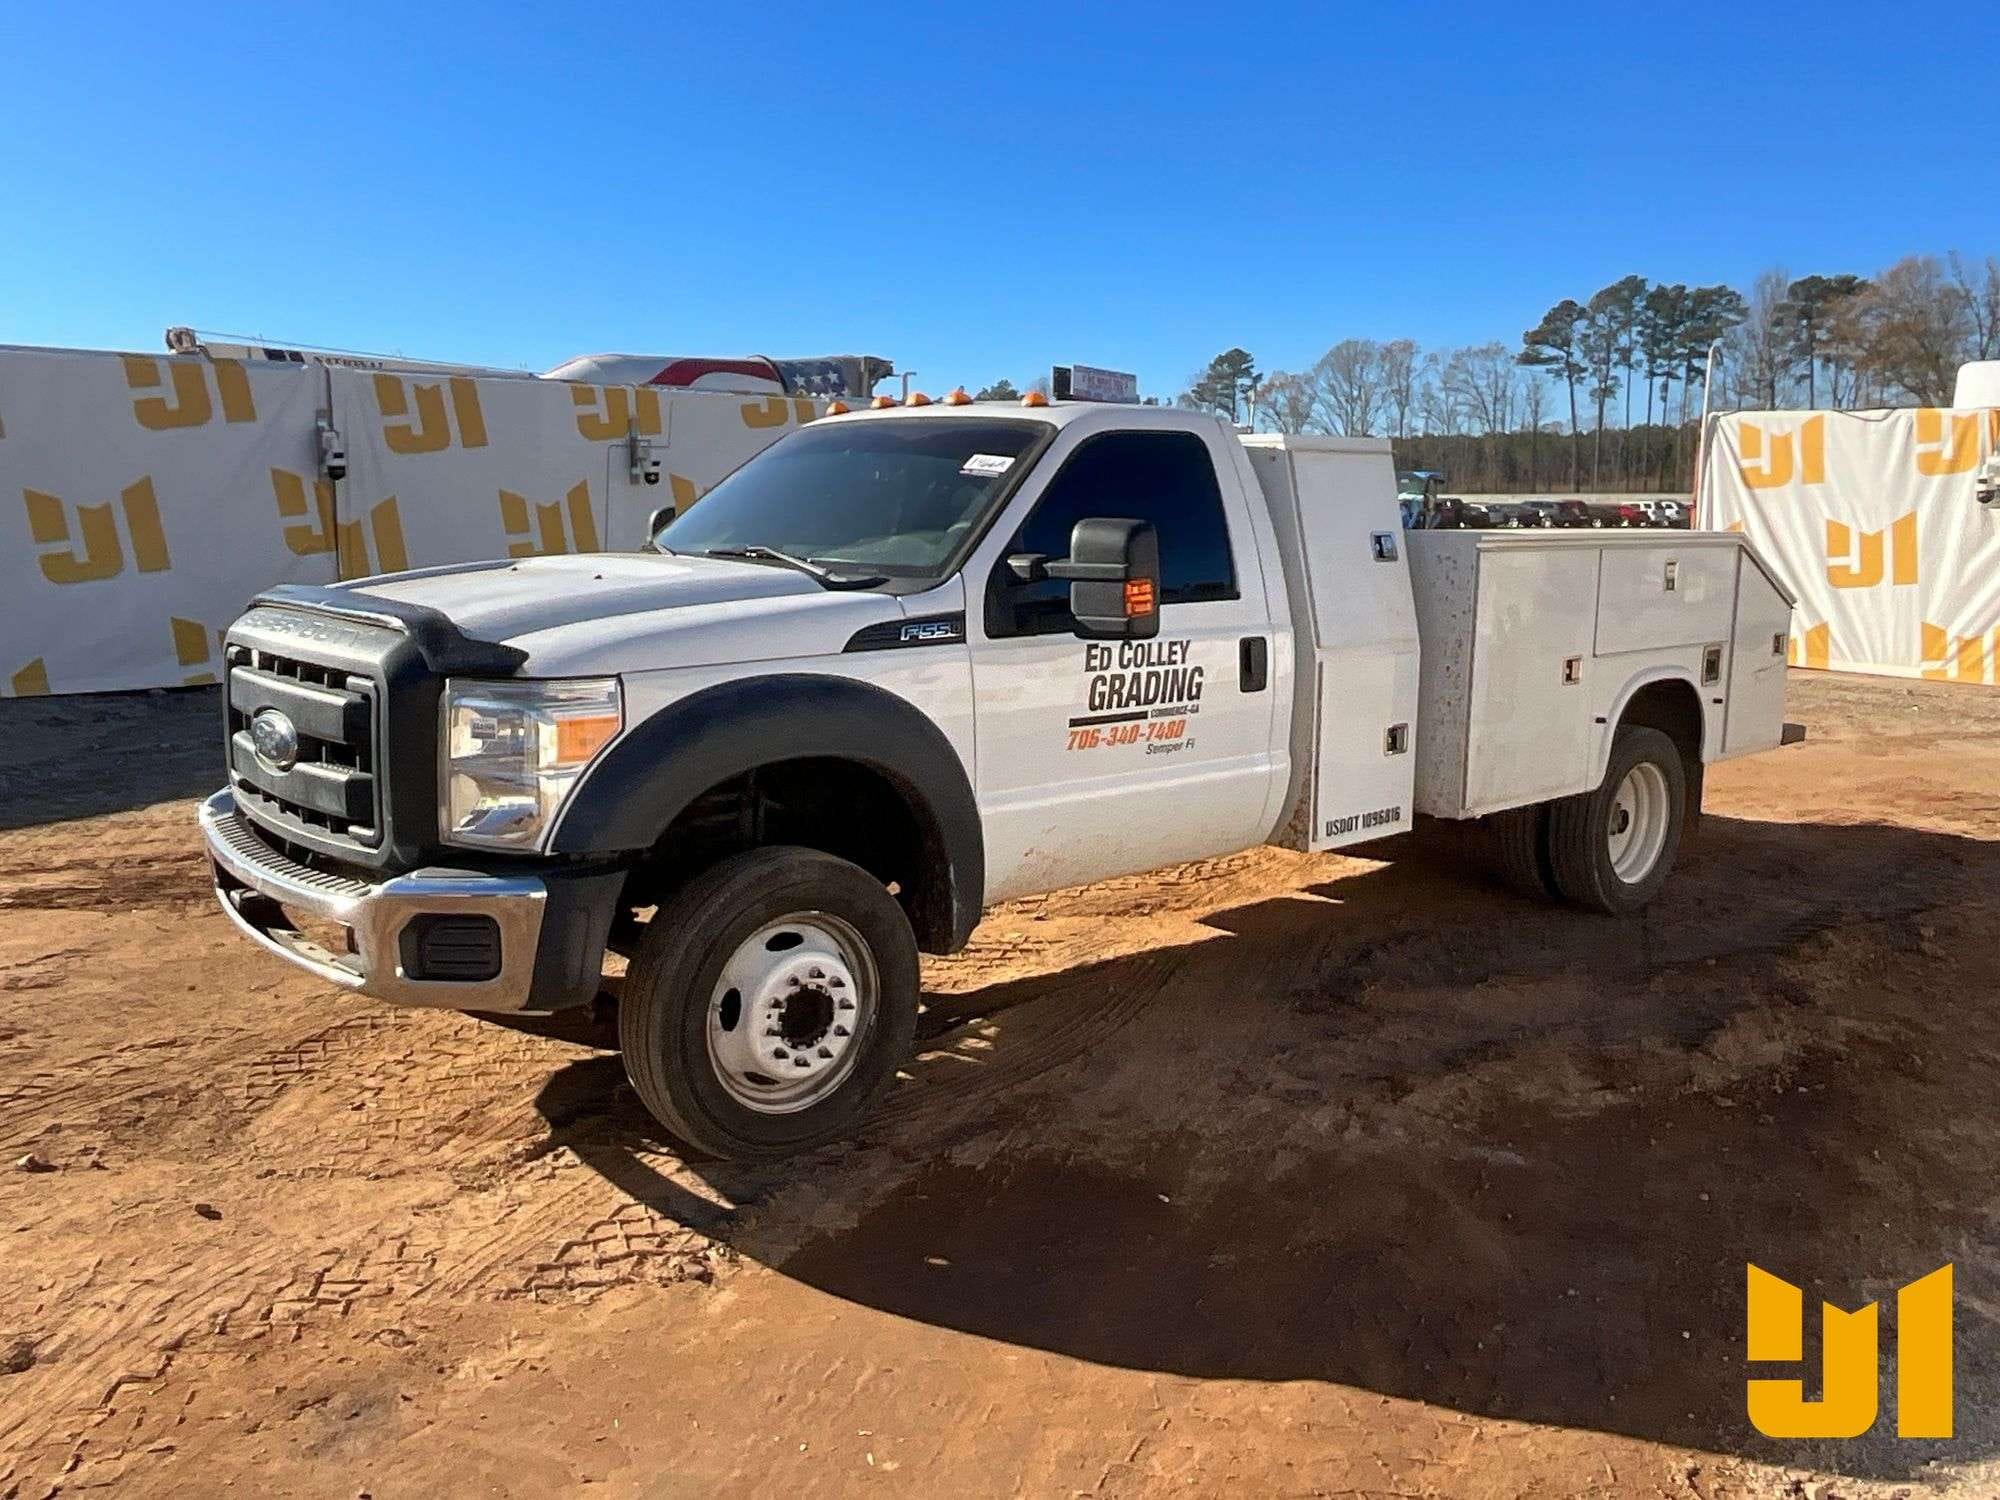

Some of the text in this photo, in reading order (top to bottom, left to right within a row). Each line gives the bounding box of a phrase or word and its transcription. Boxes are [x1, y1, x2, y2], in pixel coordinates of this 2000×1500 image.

[1084, 639, 1192, 673] ED COLLEY
[1088, 666, 1204, 712] GRADING
[1145, 742, 1184, 755] Semper
[1325, 815, 1360, 837] USDOT
